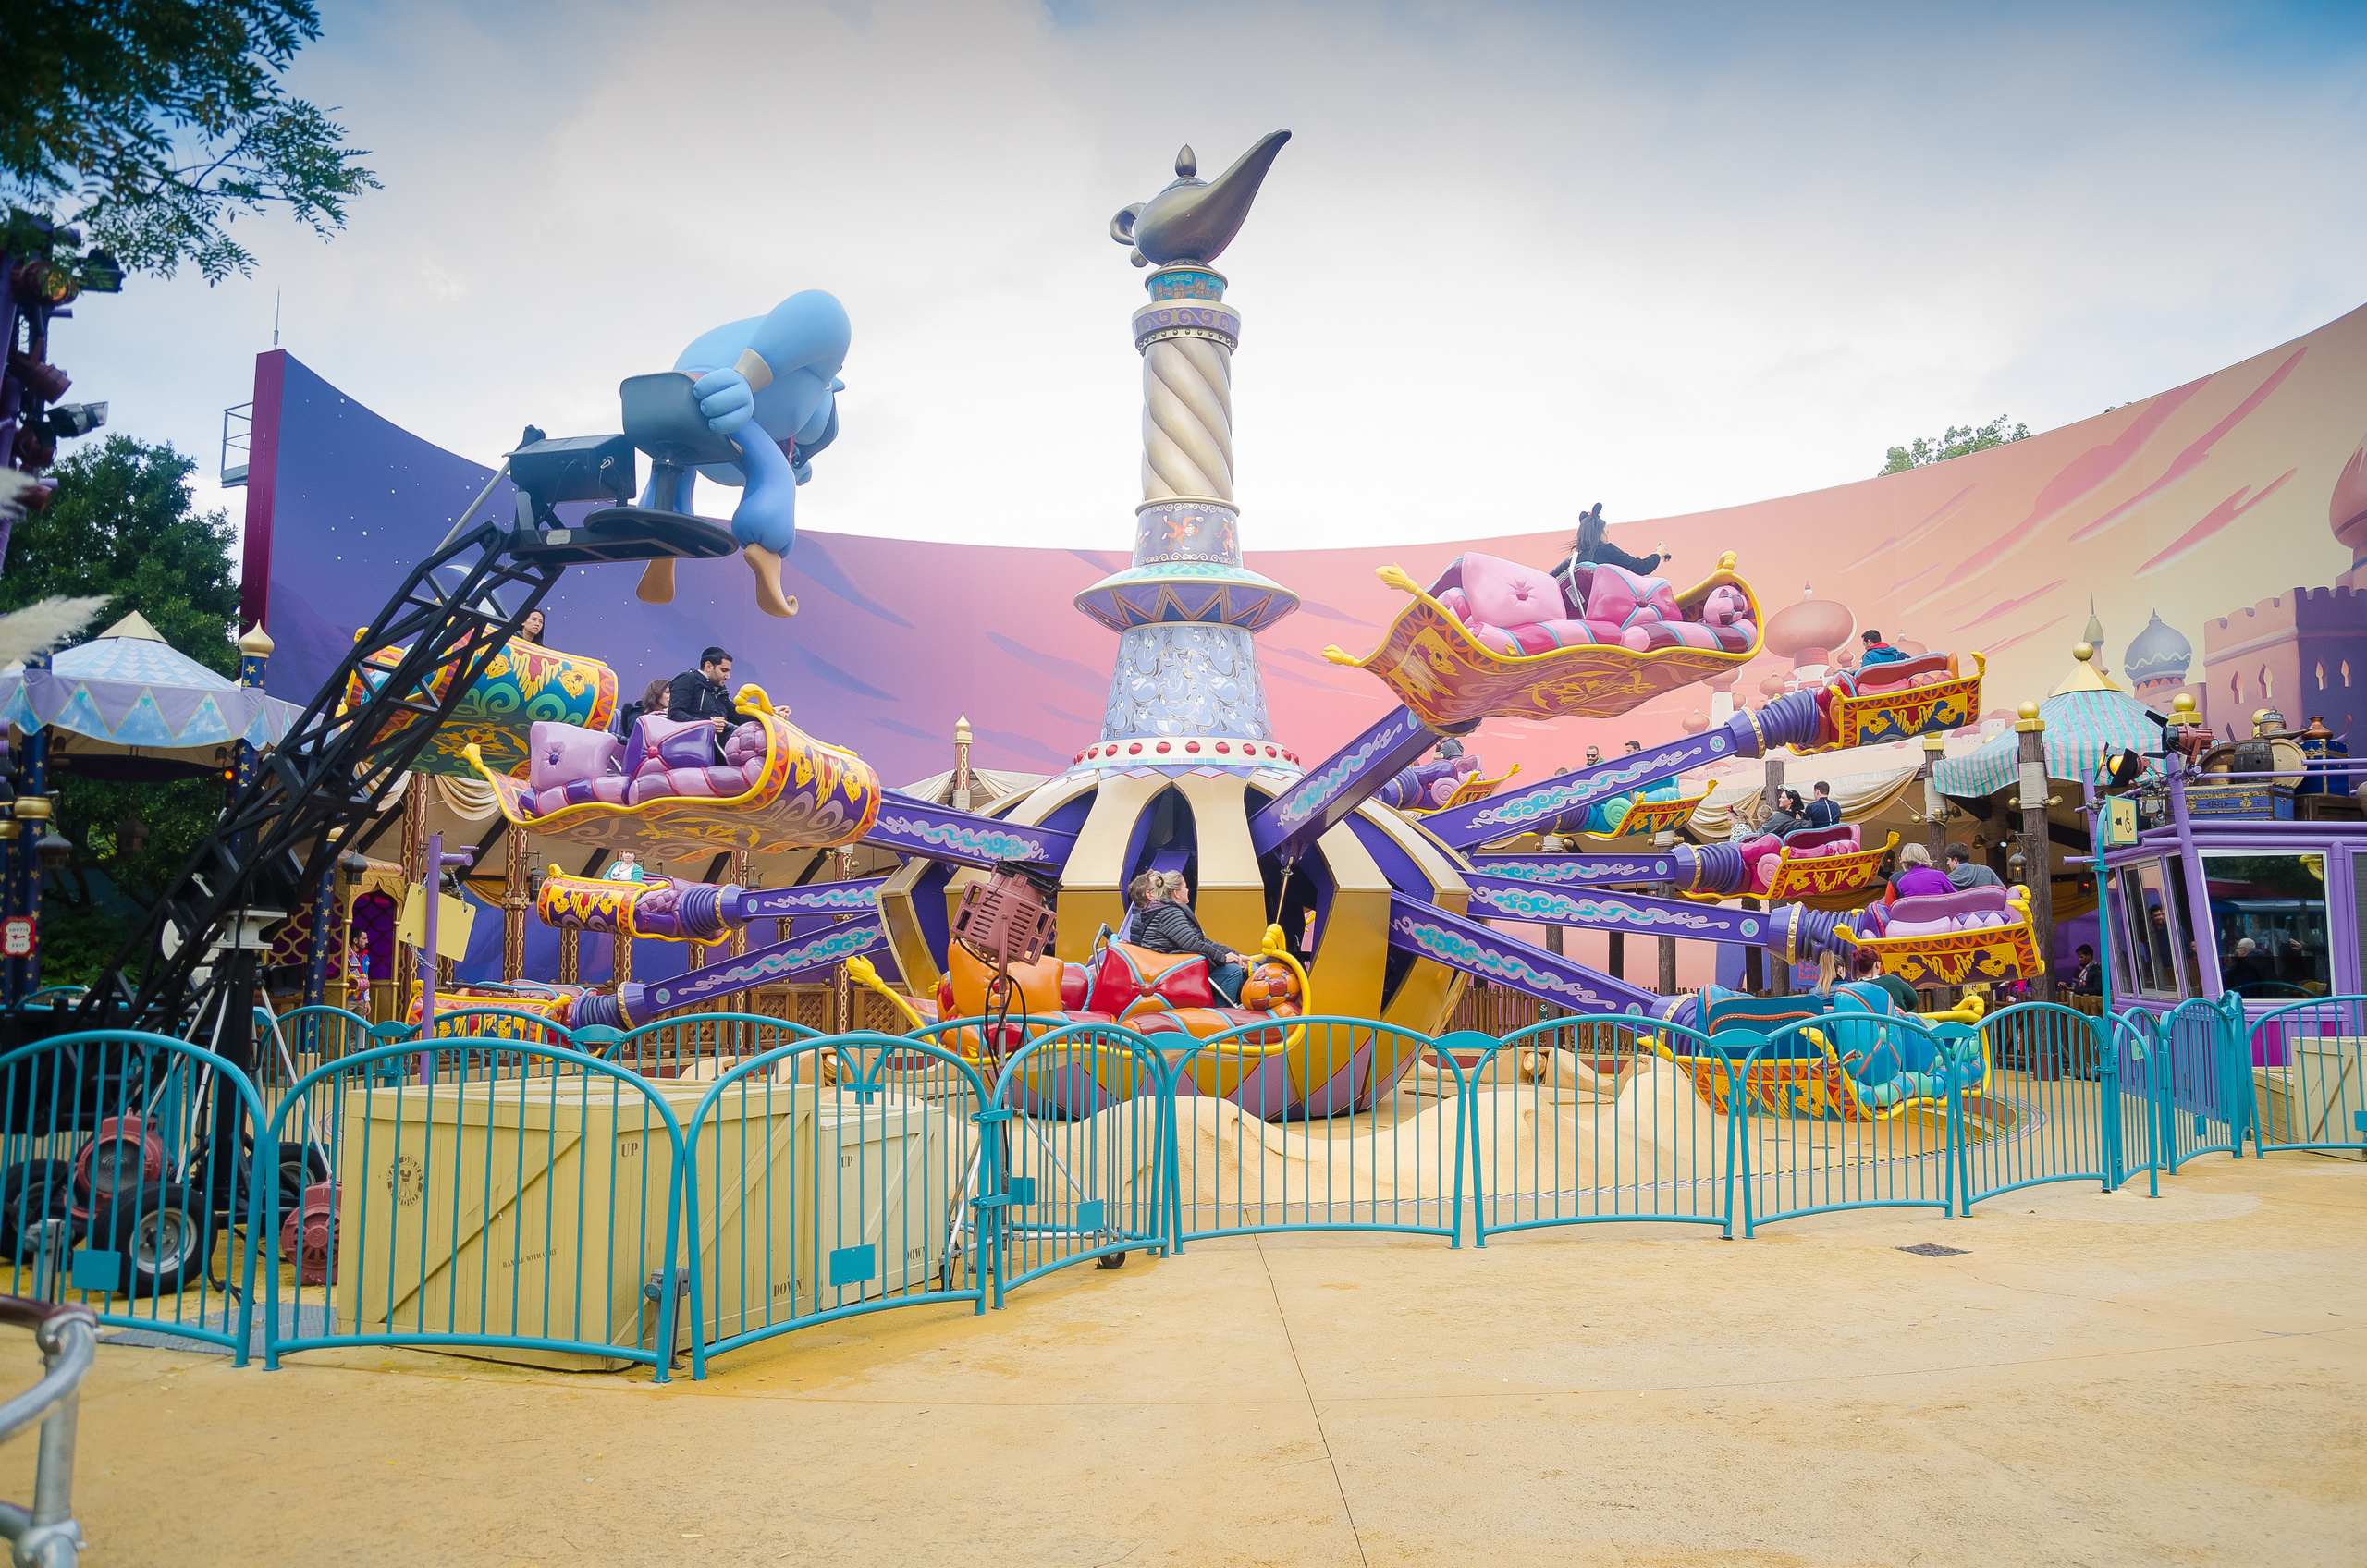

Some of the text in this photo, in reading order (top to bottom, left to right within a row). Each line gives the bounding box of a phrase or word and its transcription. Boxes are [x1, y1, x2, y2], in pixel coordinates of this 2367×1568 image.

[621, 1142, 638, 1158] UP
[841, 1156, 853, 1168] UP
[502, 1249, 557, 1268] HANLE WITH CRE
